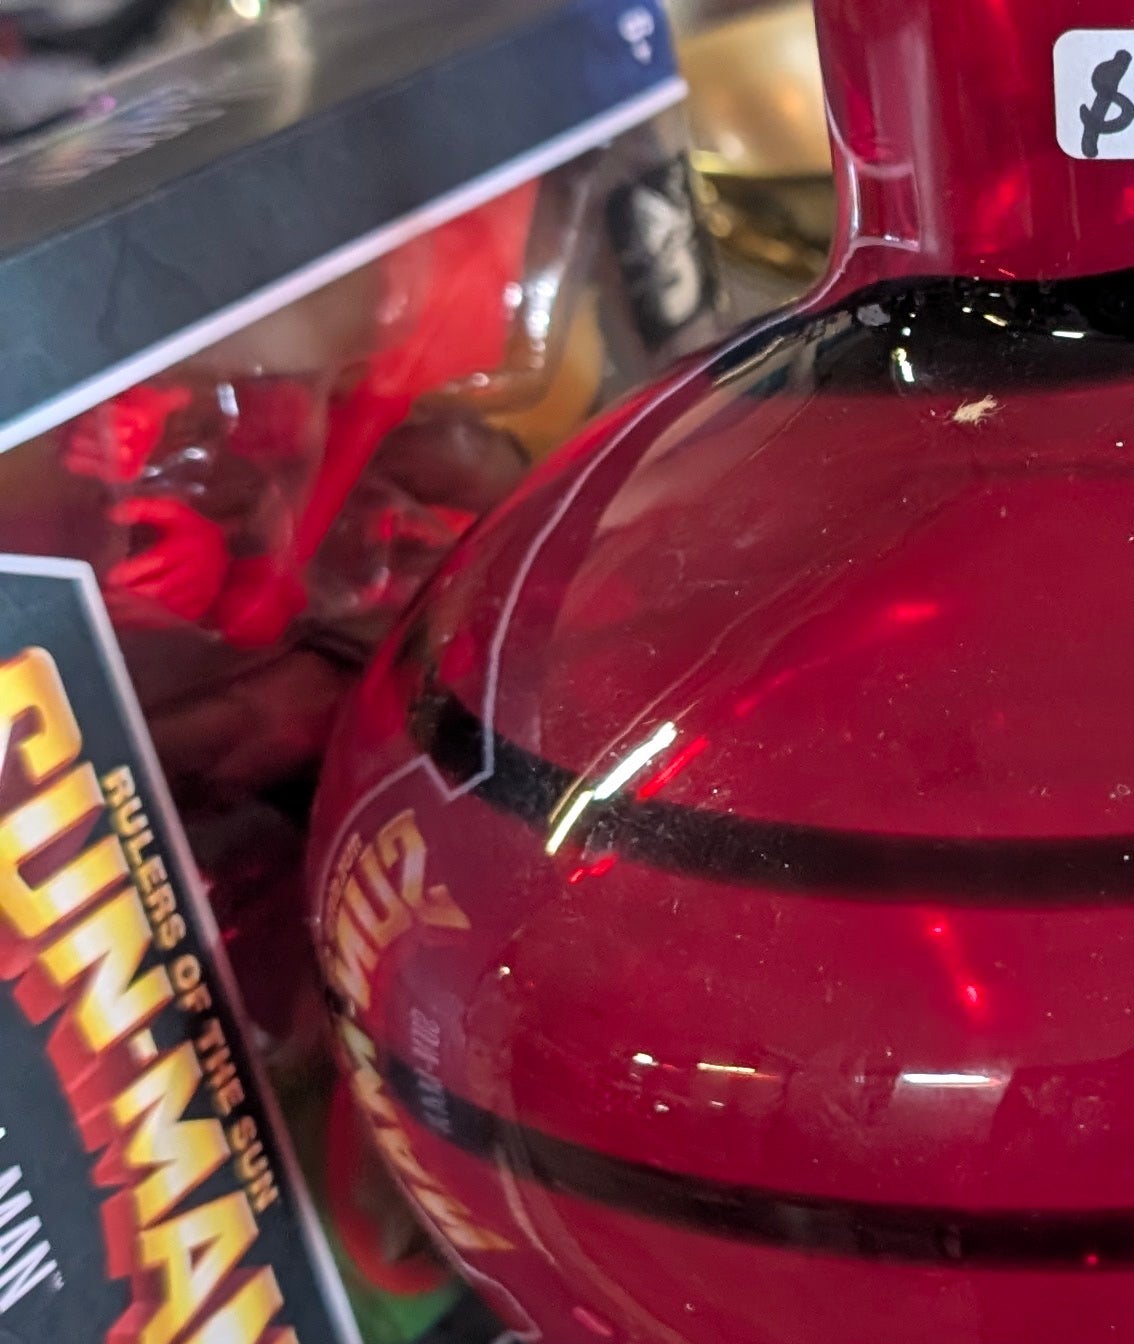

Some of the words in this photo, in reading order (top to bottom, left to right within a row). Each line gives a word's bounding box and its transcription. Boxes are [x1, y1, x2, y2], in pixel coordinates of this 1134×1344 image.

[101, 763, 188, 951] RULERS
[170, 953, 213, 1013] OF
[197, 1016, 247, 1117] THE
[230, 1114, 280, 1213] SUN
